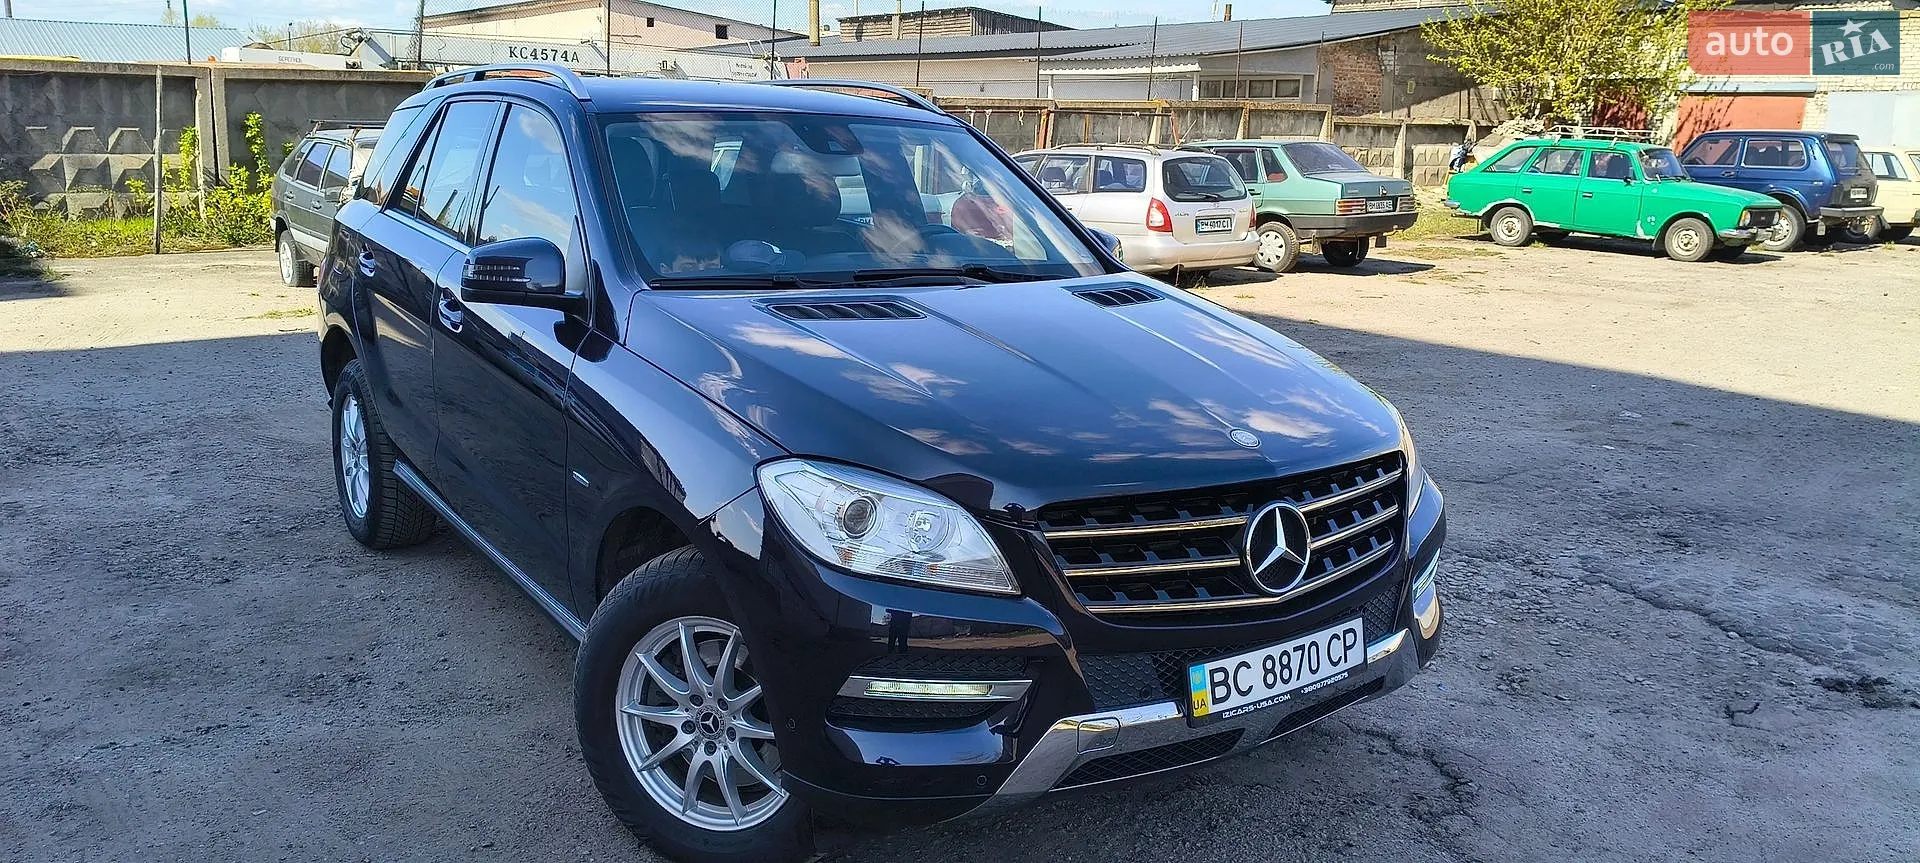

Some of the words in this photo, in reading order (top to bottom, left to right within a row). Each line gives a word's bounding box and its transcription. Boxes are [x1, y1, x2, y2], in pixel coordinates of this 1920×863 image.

[1193, 697, 1207, 712] UA
[1208, 660, 1254, 706] BC
[1262, 640, 1321, 690] 8870
[1326, 627, 1358, 668] CP
